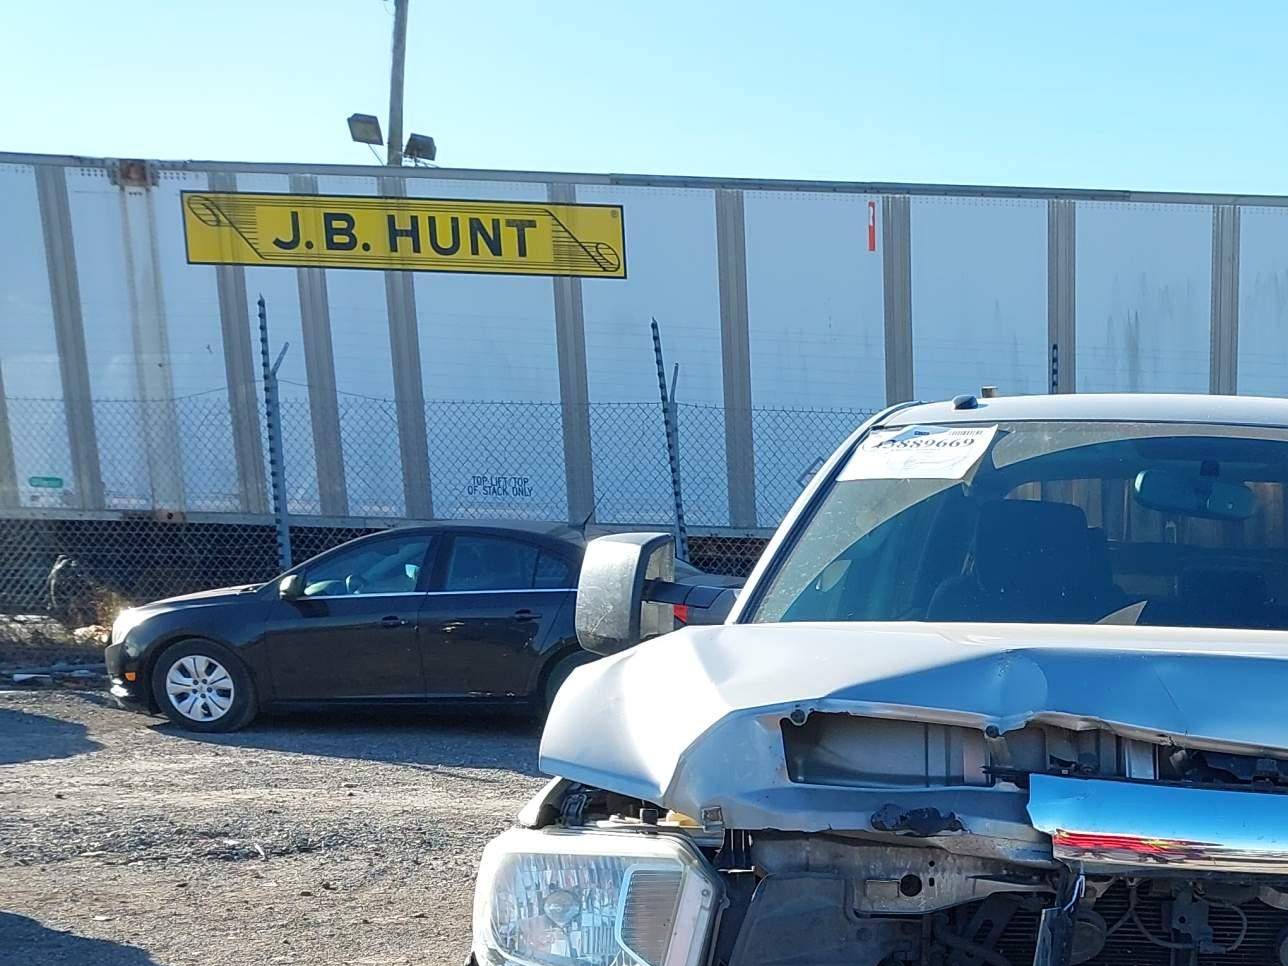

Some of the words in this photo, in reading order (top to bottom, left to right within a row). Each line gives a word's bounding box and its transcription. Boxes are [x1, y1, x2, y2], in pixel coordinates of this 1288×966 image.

[273, 211, 371, 251] J.B.
[387, 214, 537, 257] HUNT
[472, 476, 488, 486] TOP
[490, 476, 508, 487] LIFT
[512, 477, 529, 487] TOP
[467, 486, 479, 496] OF
[483, 486, 509, 497] STACK
[512, 486, 533, 497] ONLY
